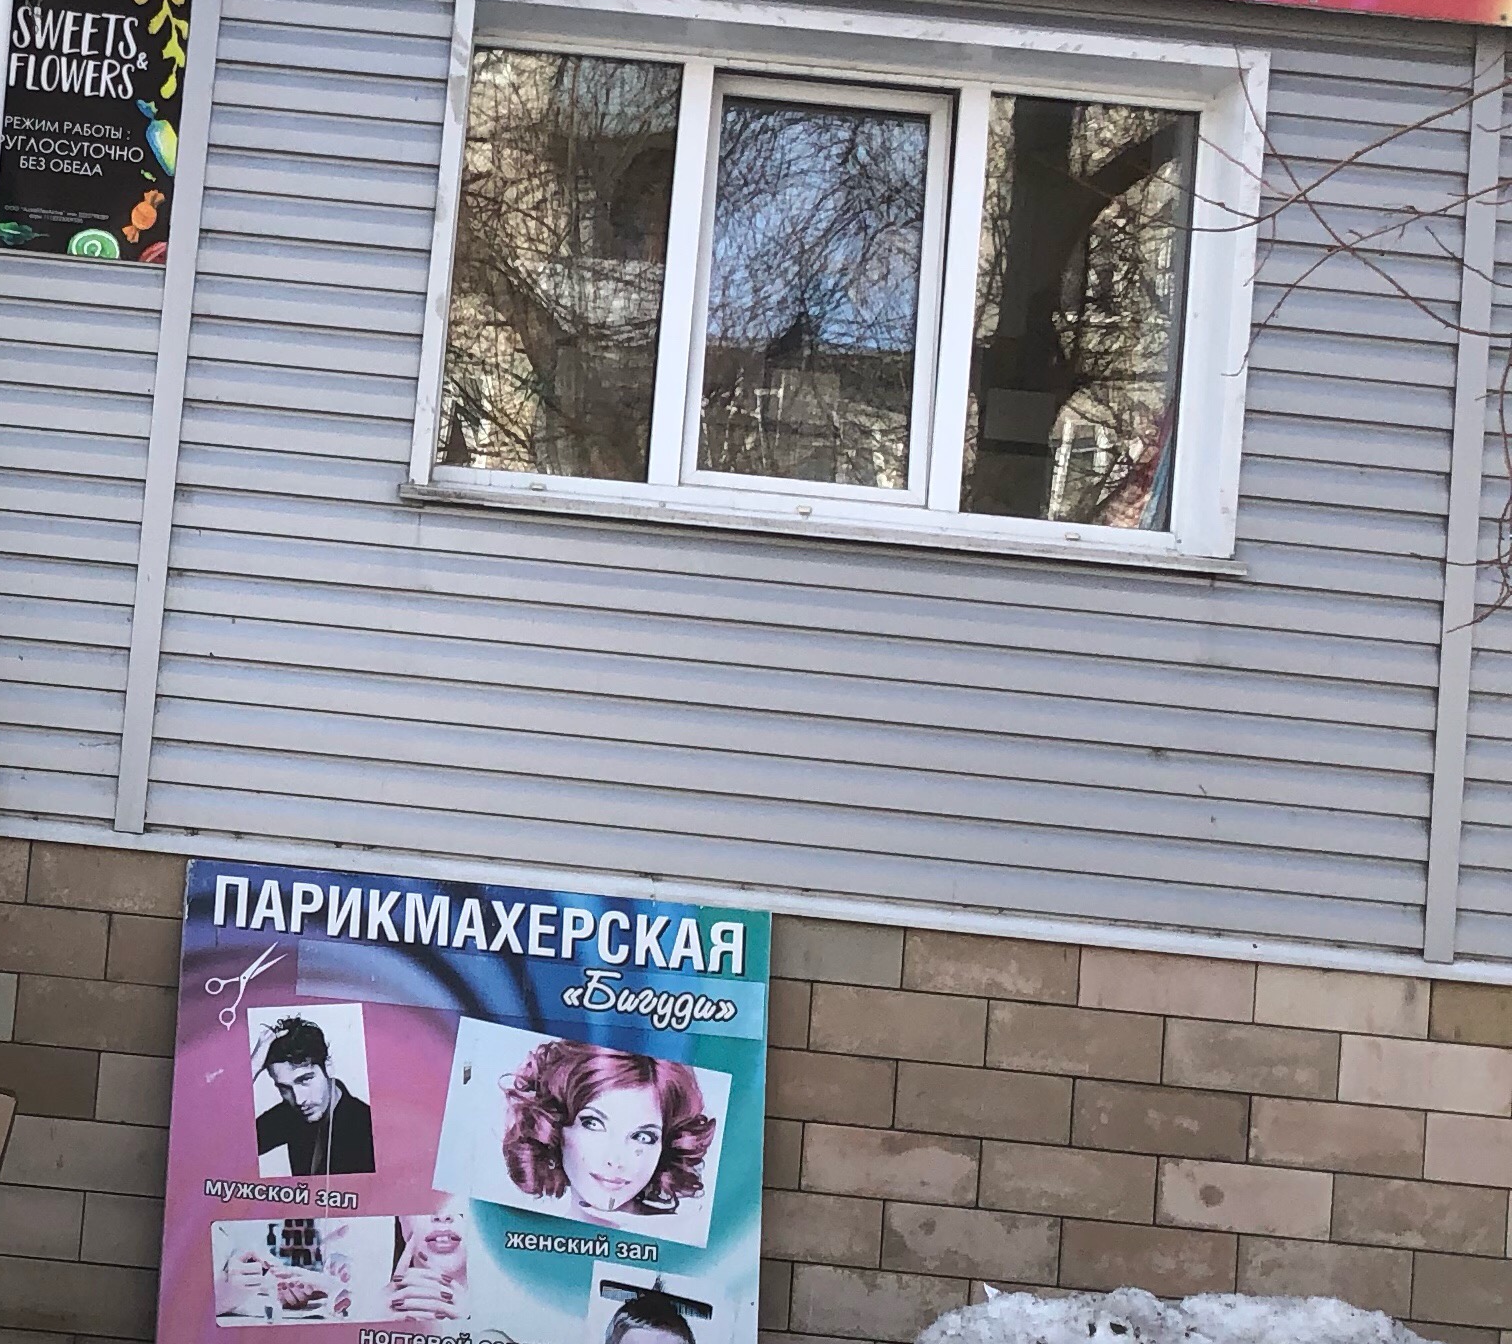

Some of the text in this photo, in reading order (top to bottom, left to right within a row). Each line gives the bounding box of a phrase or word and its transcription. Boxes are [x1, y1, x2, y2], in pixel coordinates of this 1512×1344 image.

[12, 6, 139, 59] SWEETS
[8, 53, 135, 99] FLOWERS
[4, 115, 59, 133] РЕЖИМ
[63, 121, 123, 140] РАБОТЫ
[19, 155, 103, 177] БЕЗ ОБЕДА
[213, 874, 746, 975] ПАРИКМАХЕРСКАЯ
[204, 1177, 359, 1210] мужской зал
[505, 1230, 658, 1261] женский зал
